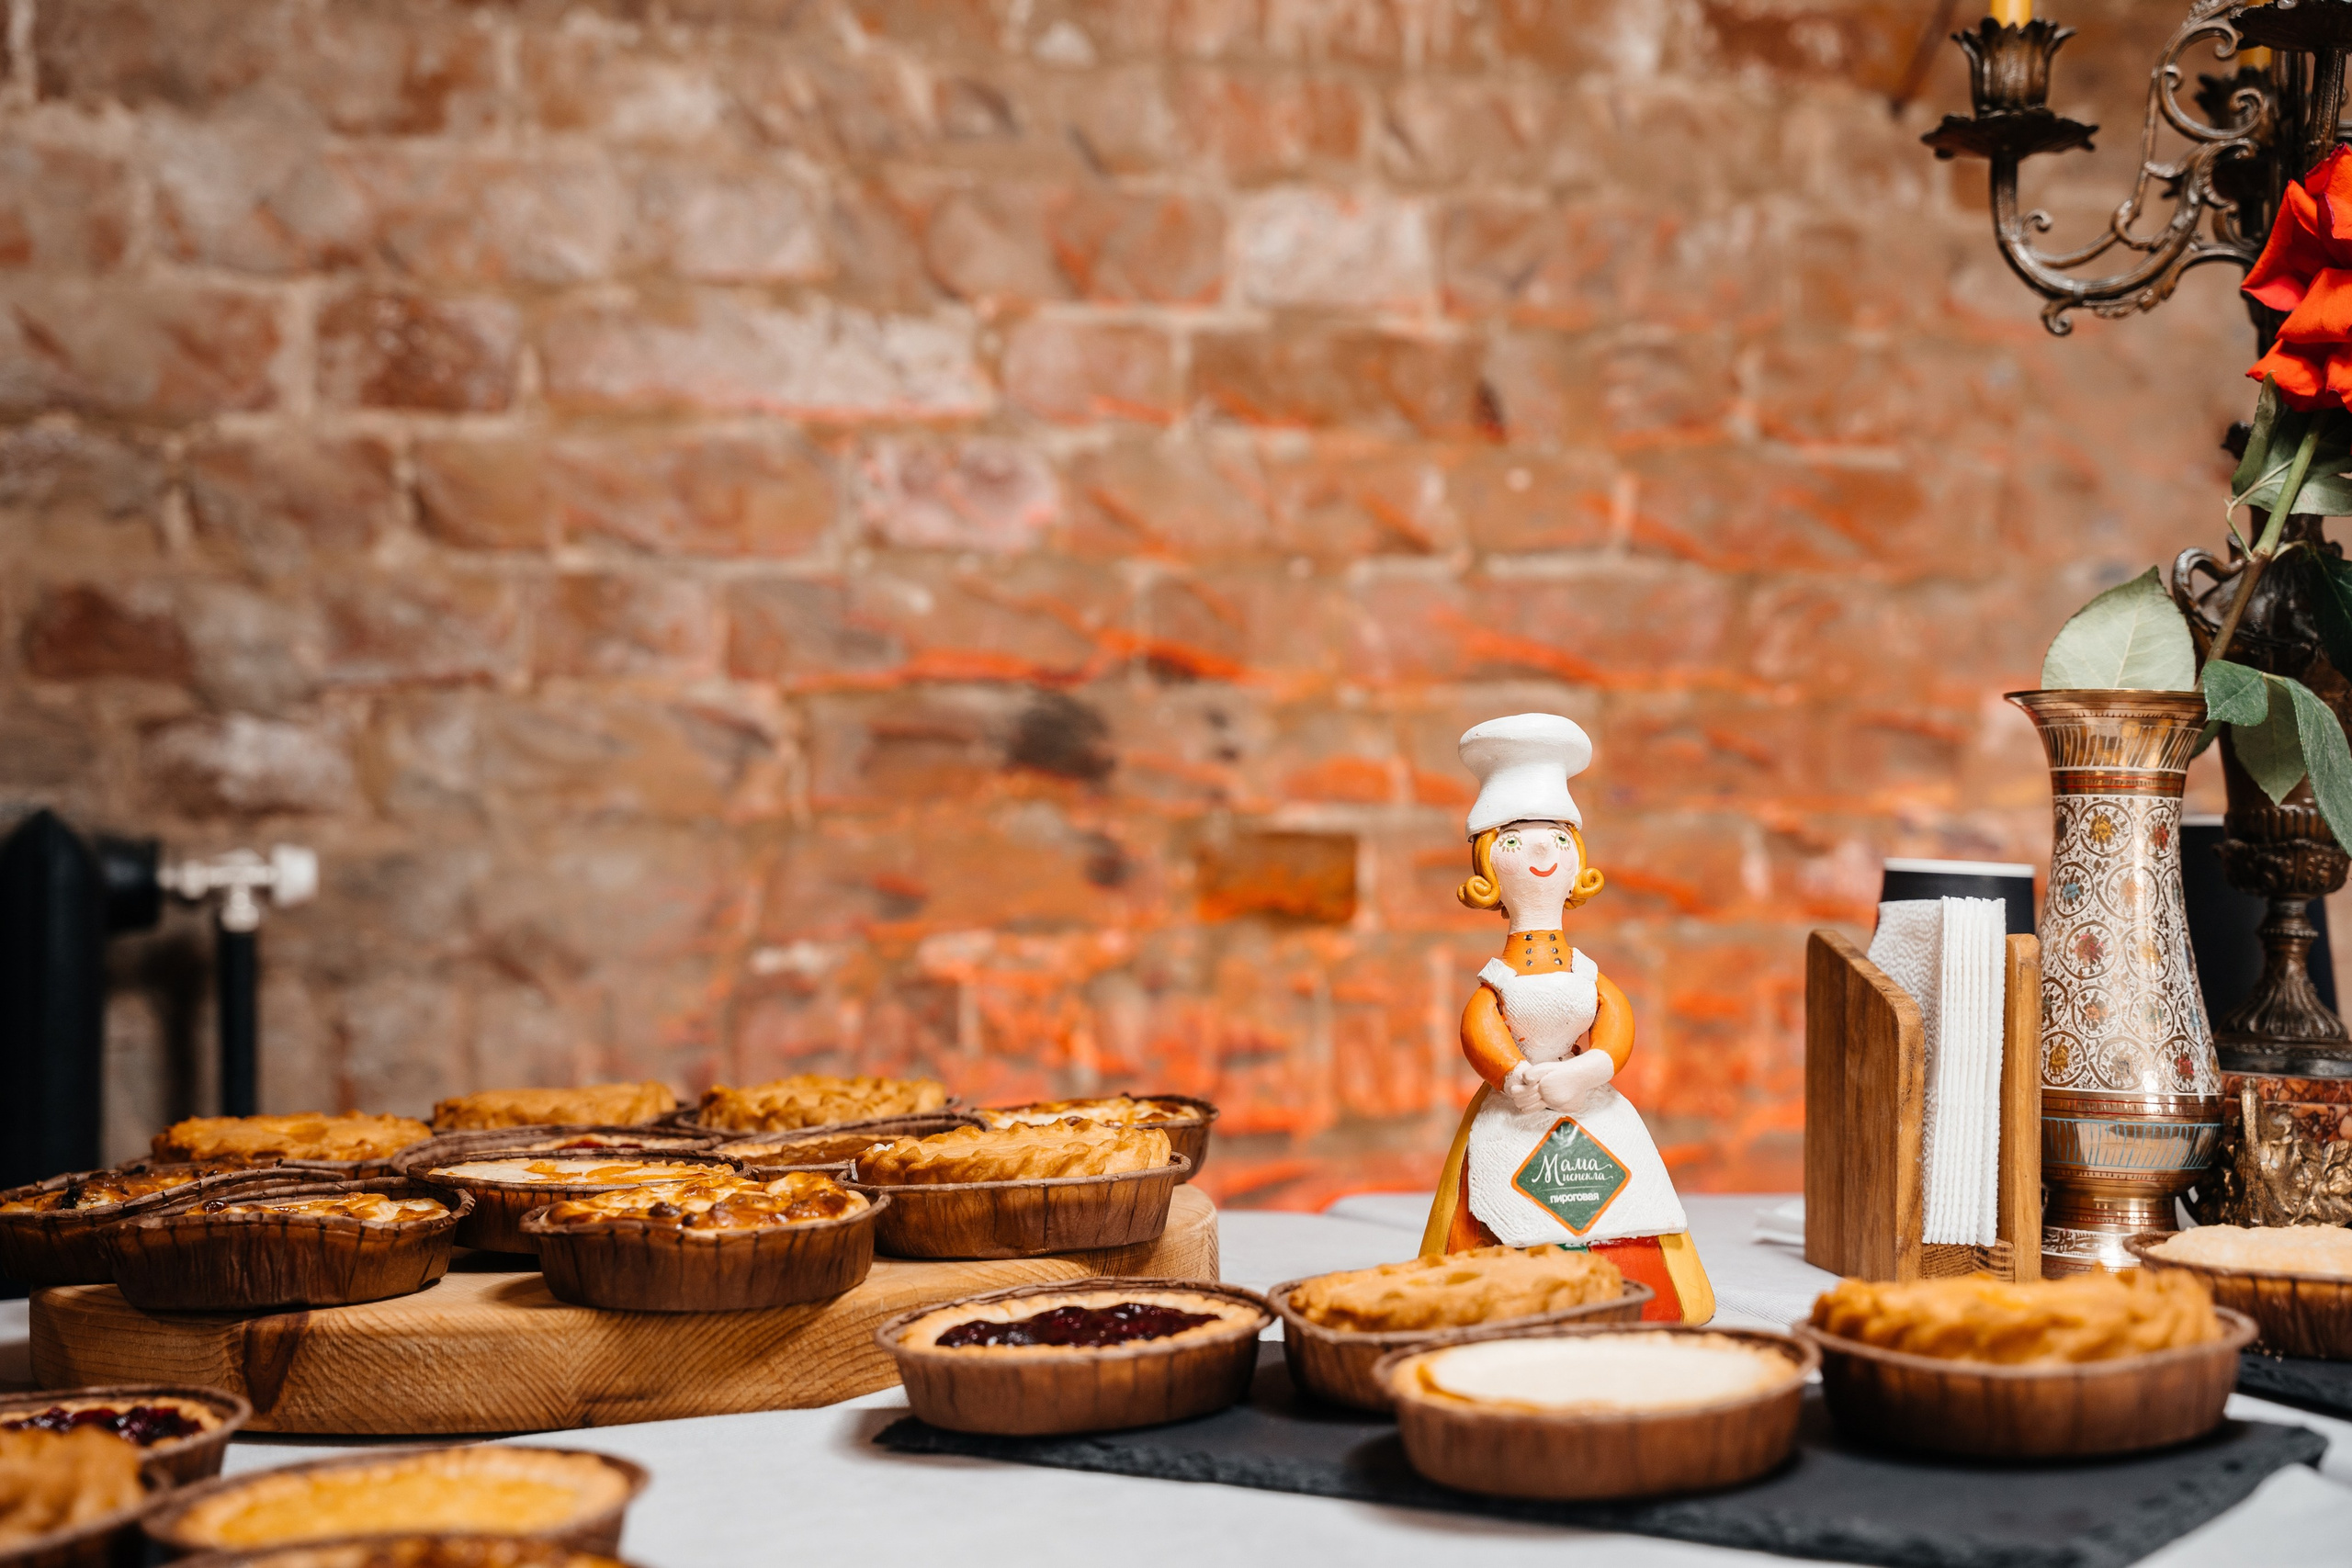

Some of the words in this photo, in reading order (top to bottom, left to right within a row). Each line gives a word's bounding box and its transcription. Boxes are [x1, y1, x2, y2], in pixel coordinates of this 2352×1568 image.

[1532, 1154, 1612, 1186] Мама
[1563, 1171, 1613, 1182] испекла
[1550, 1192, 1600, 1204] пироговая
